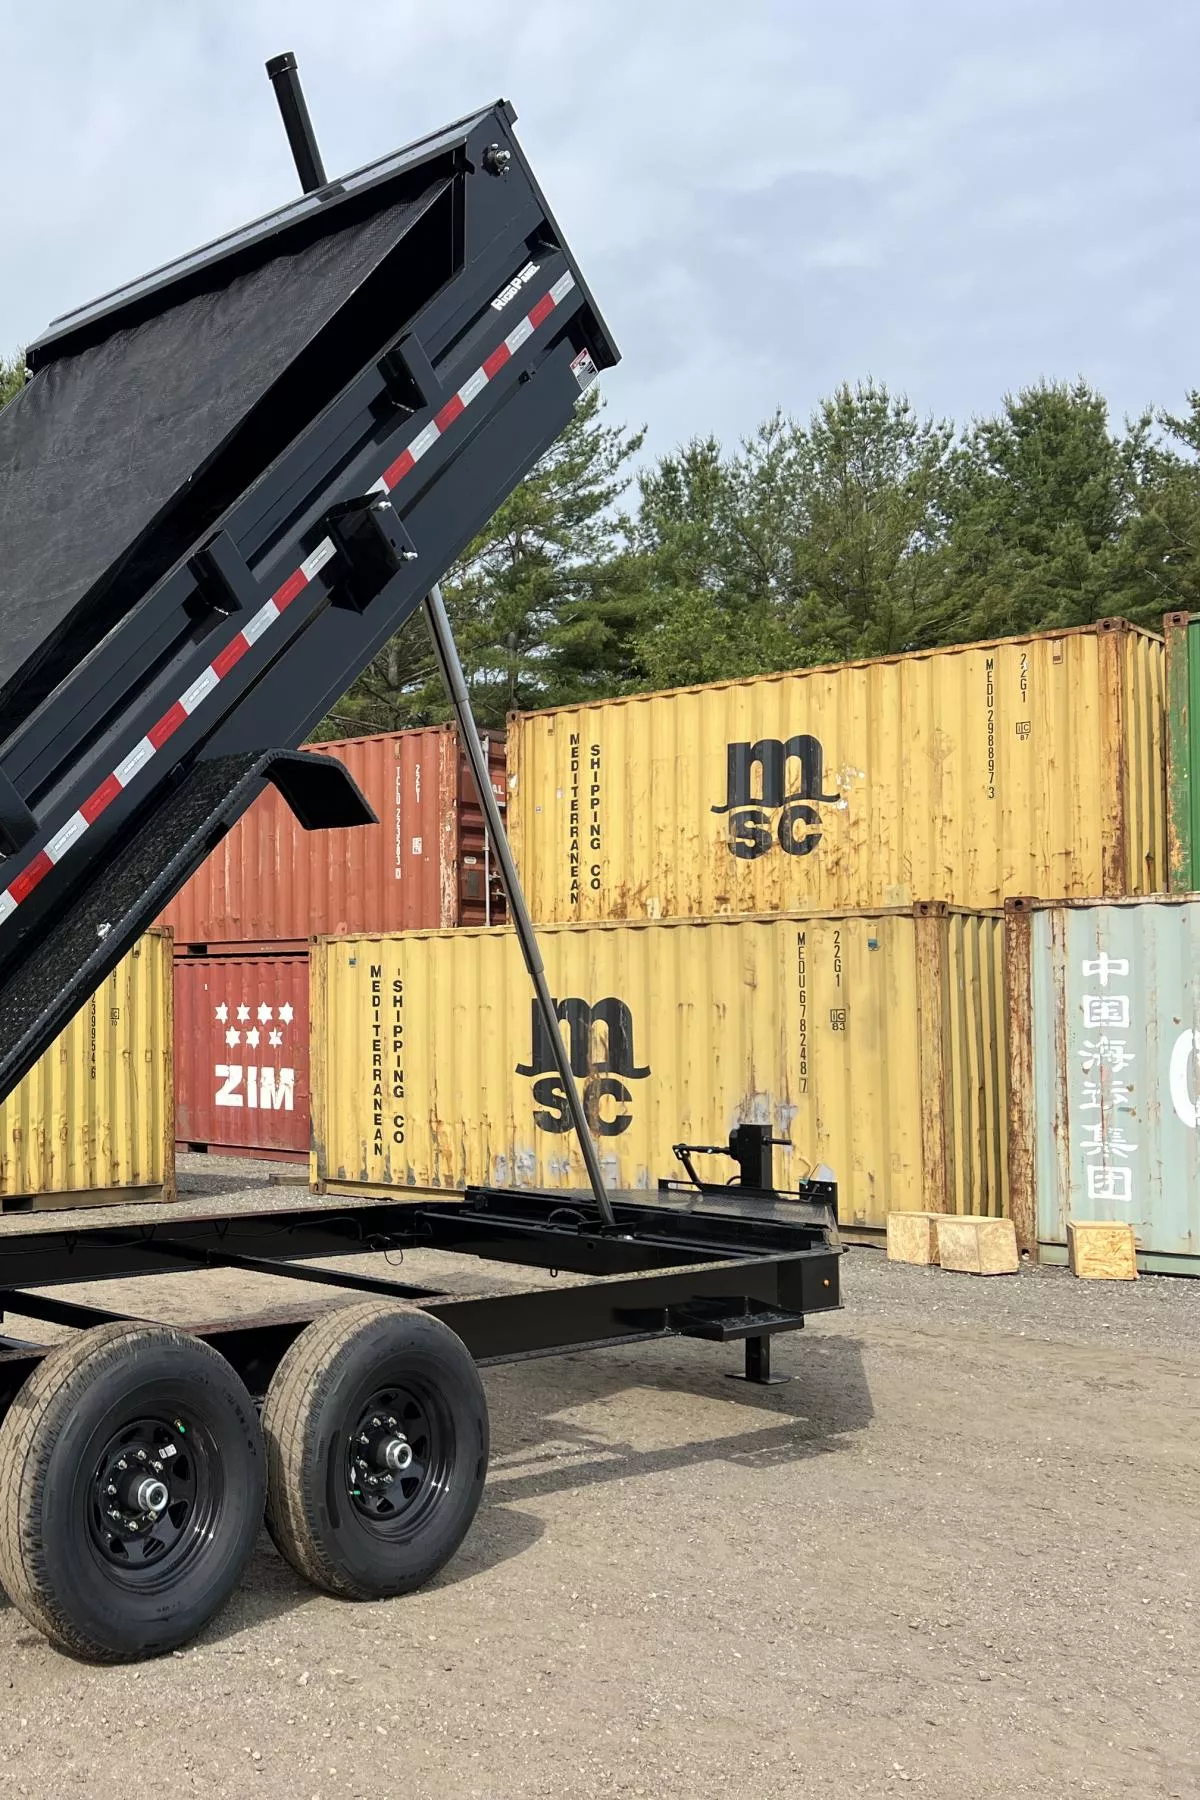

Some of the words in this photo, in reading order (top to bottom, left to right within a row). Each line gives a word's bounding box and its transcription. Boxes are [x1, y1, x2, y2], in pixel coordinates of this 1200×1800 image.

[569, 733, 580, 904] MEDITERRANEAN
[590, 744, 601, 850] SHIPPING
[590, 864, 601, 890] CO
[797, 932, 806, 988] MEDU
[833, 930, 841, 987] 22G1
[370, 965, 383, 1156] MEDITERRANEAN
[393, 980, 405, 1098] SHIPPING
[799, 991, 807, 1075] 678248
[832, 1022, 846, 1031] 83
[215, 1064, 294, 1111] ZIM
[1078, 952, 1138, 1202] 中国海运集团
[393, 1115, 405, 1144] CO
